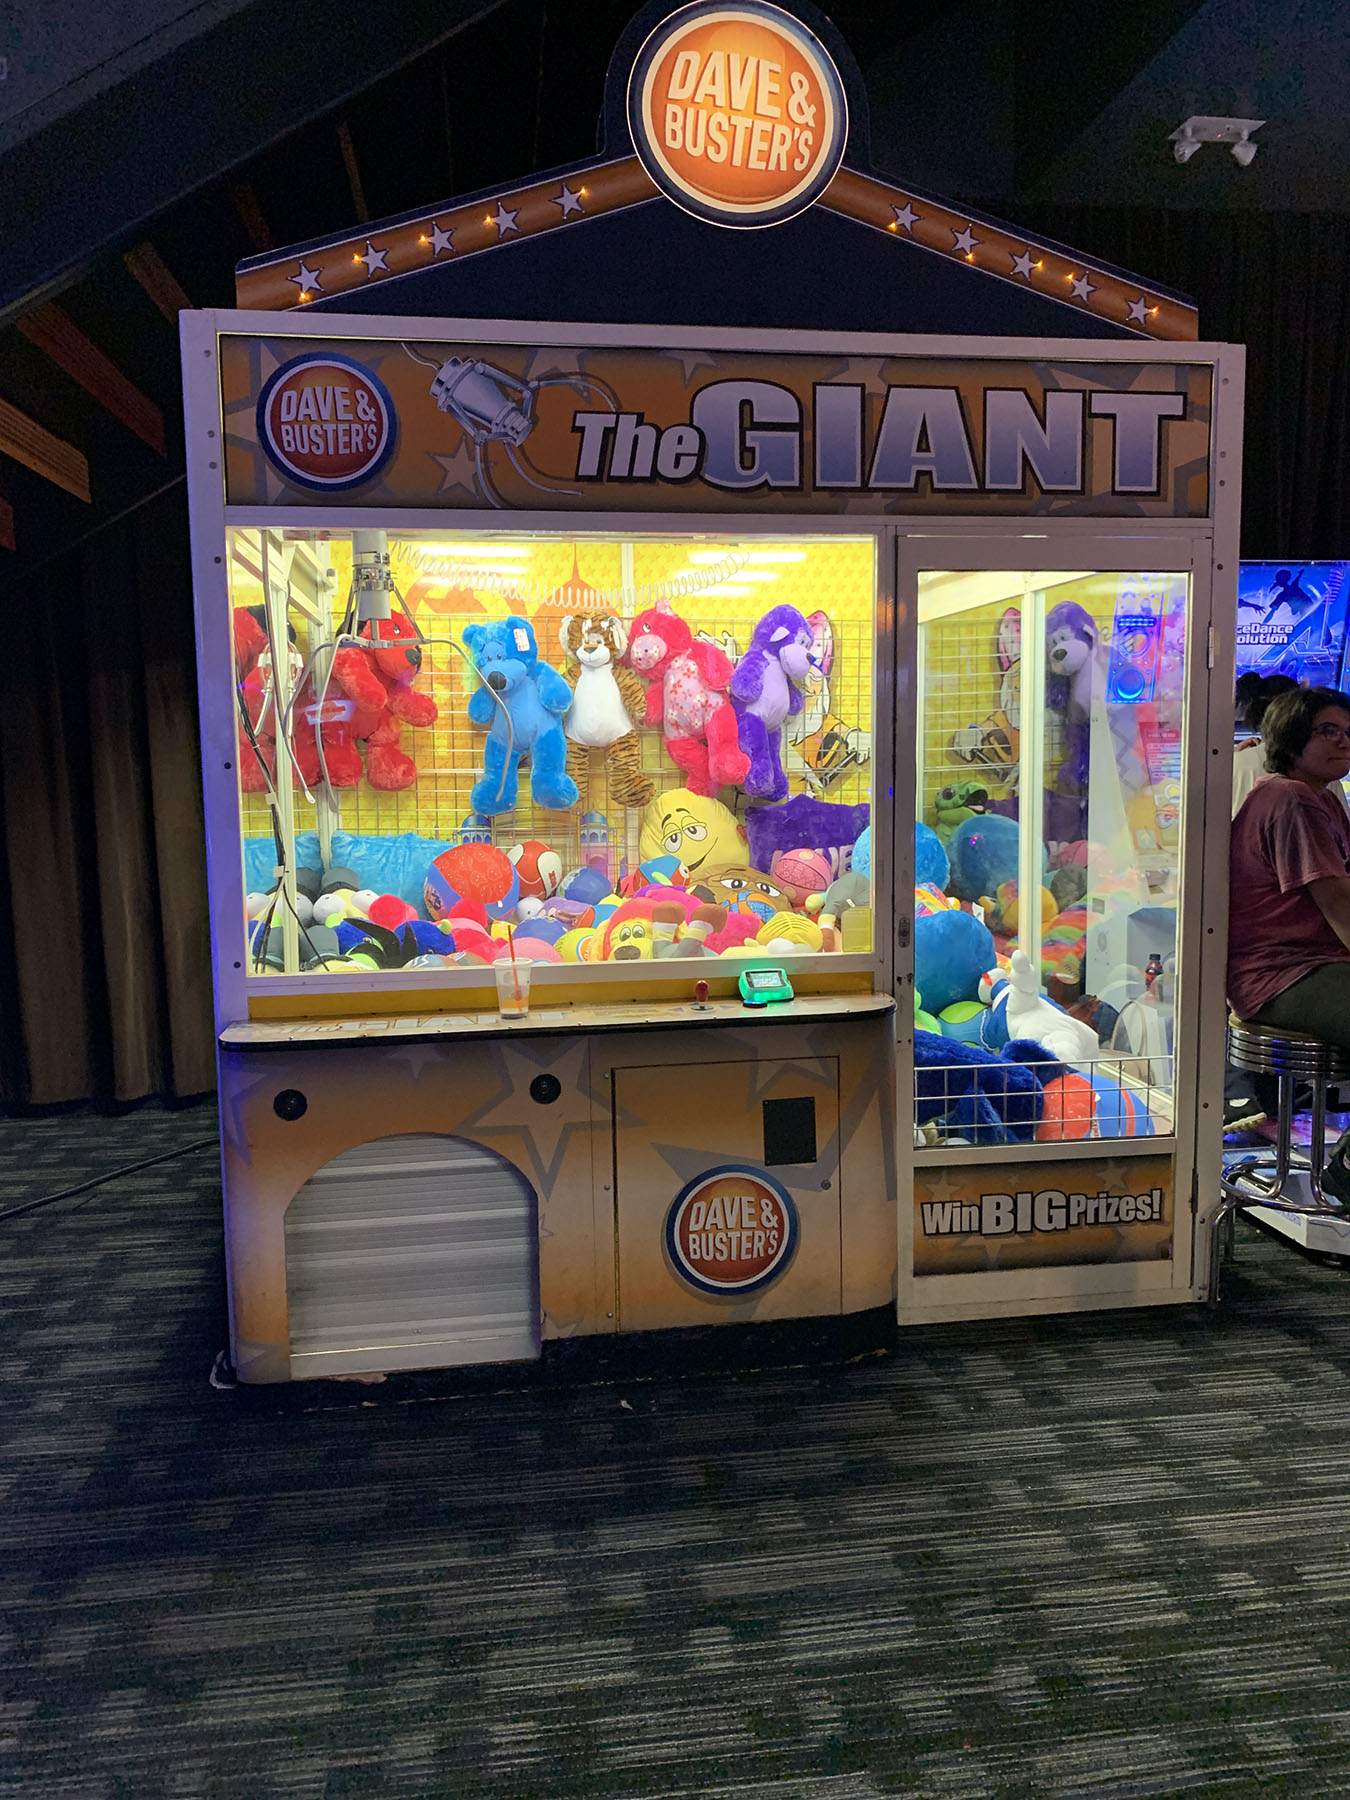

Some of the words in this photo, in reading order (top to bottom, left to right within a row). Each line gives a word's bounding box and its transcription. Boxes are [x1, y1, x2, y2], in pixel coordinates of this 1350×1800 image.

[667, 50, 782, 119] DAVE
[787, 71, 817, 128] &
[664, 103, 814, 172] BUSTER'S
[281, 386, 354, 422] DAVE
[355, 389, 377, 422] &
[281, 423, 378, 455] BUSTER'S
[572, 411, 702, 481] The
[691, 379, 1187, 494] GIANT
[688, 1196, 758, 1232] DAVE
[760, 1198, 779, 1229] &
[921, 1201, 980, 1236] Win
[981, 1189, 1067, 1235] BIG
[1069, 1188, 1162, 1225] Prizes!
[688, 1229, 779, 1262] BUSTER'S
